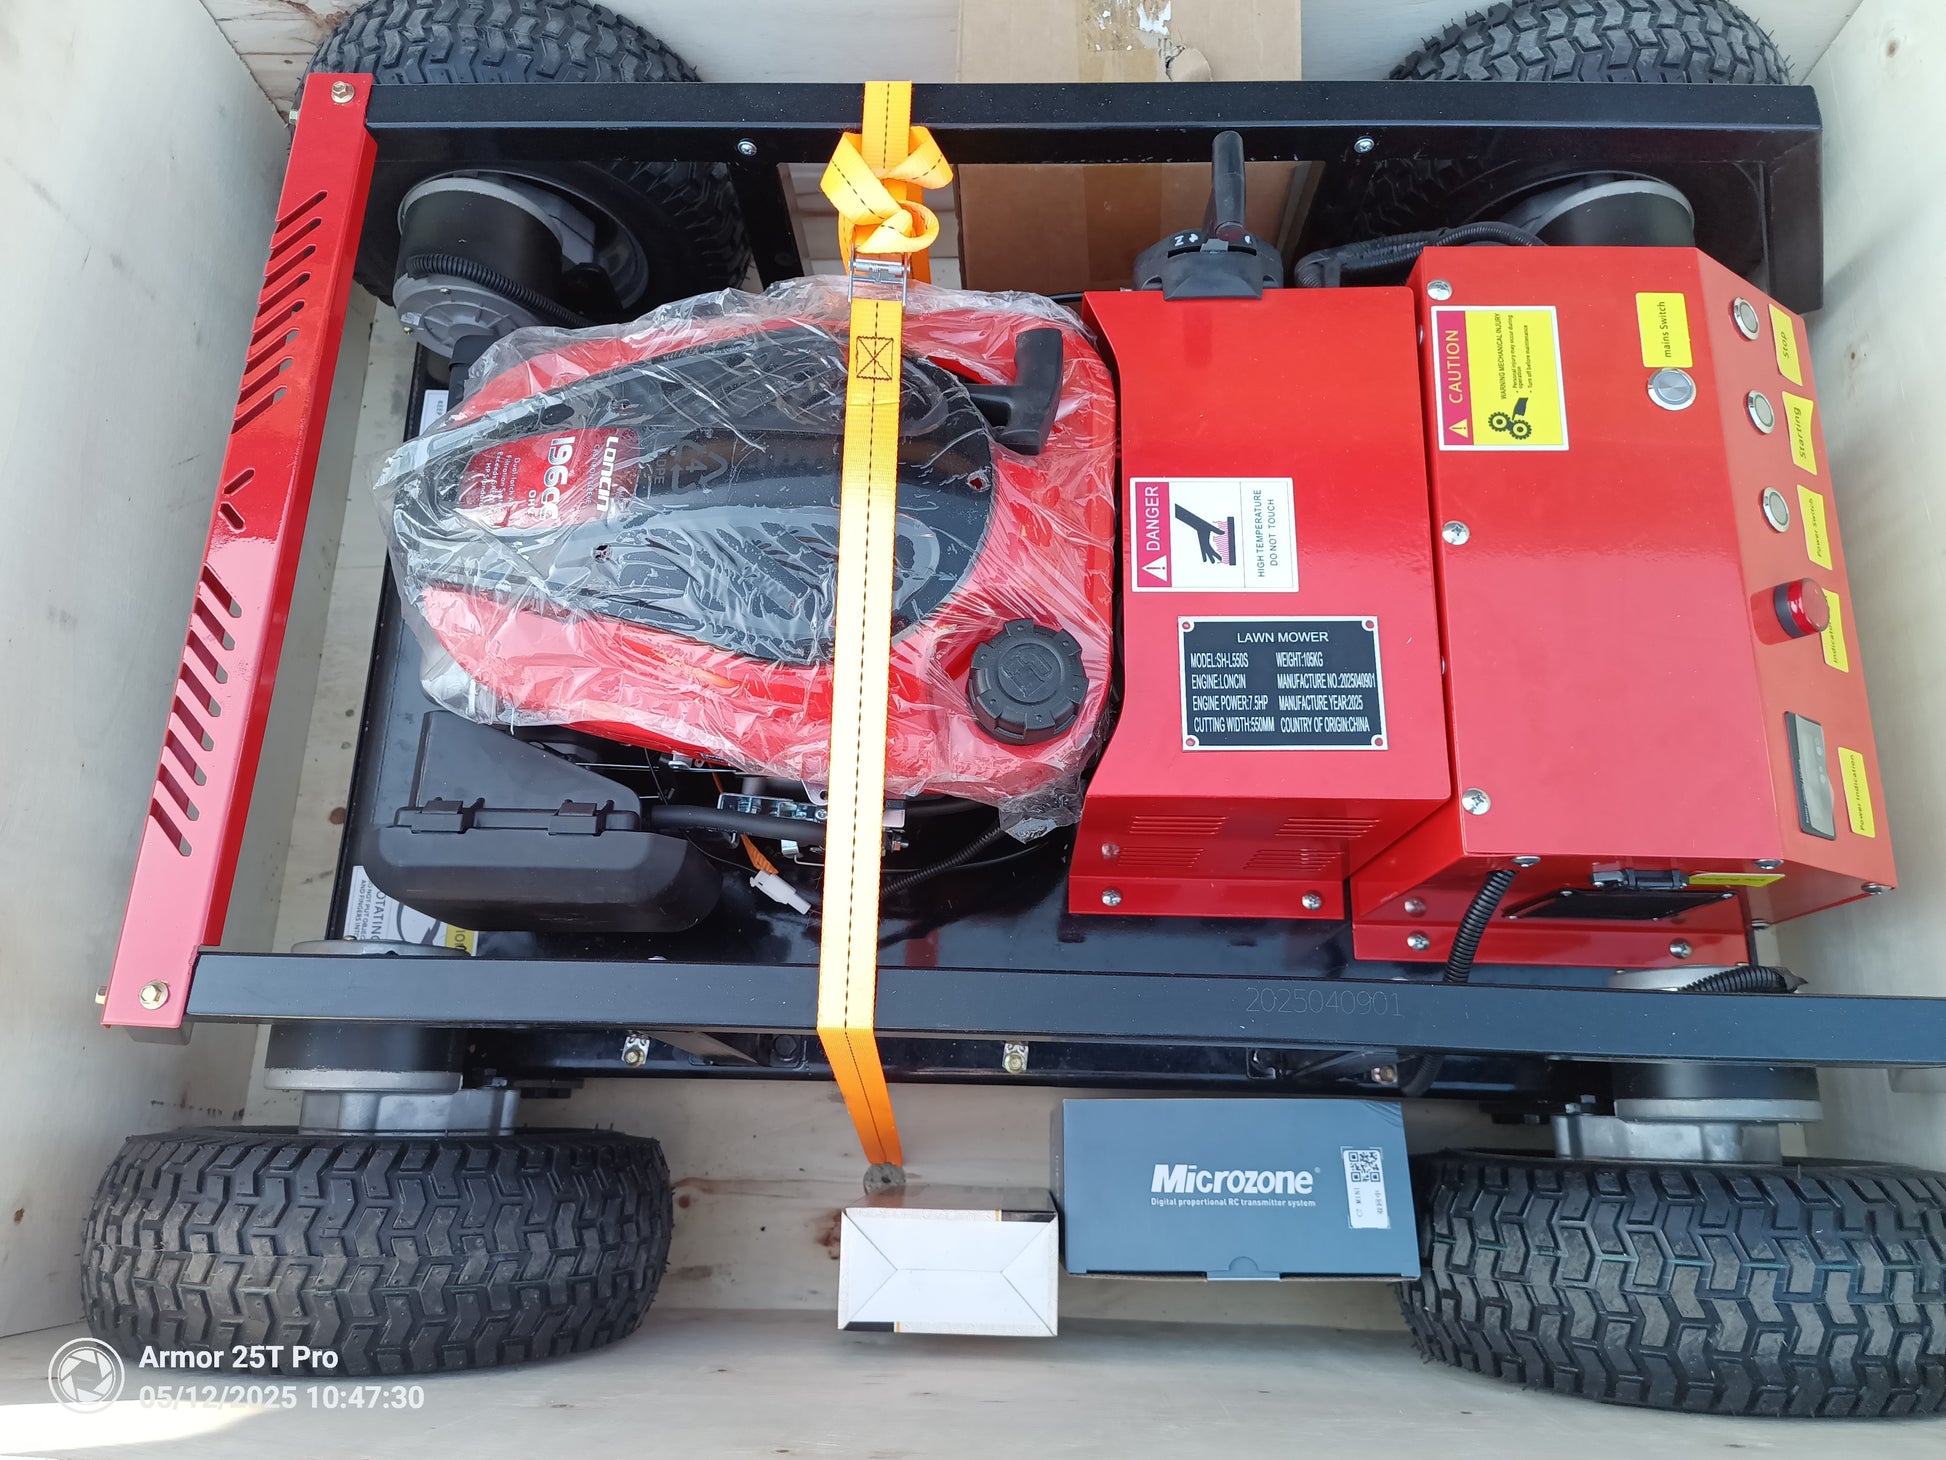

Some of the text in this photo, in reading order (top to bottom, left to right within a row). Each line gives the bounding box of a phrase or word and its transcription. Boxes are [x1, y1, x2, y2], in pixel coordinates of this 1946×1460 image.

[1656, 301, 1672, 358] mains Switch
[1494, 313, 1507, 400] WARNING MECHANICAL INJURY
[1781, 331, 1789, 359] Stop
[1445, 330, 1463, 404] CAUTION
[1794, 406, 1807, 459] Starting
[1144, 486, 1160, 551] DANGER
[1267, 499, 1278, 566] DO NOT TOUCH
[1808, 498, 1822, 558] Power Switch
[1253, 490, 1264, 578] HIGH TEMPERATURE
[1237, 632, 1329, 643] LAWN MOWER
[1190, 652, 1249, 668] MODEL:SH-L550S
[1276, 652, 1324, 668] WEIGHT:105KG
[1192, 674, 1246, 690] ENGINE:LONCIN
[1277, 674, 1326, 689] MANUFACTURE
[1192, 694, 1268, 711] ENGINE POWER:7.5HP
[1278, 694, 1364, 711] MANUFACTURE YEAR:2025
[1194, 716, 1275, 732] CUTTING WIDTH:550MM
[1280, 716, 1370, 732] COUNTRY OF ORIGIN:CHINA
[356, 894, 364, 922] FINGERS
[364, 889, 372, 904] NOT
[1246, 987, 1403, 1016] 2025040901
[1151, 1164, 1314, 1194] Microzone
[1151, 1198, 1316, 1208] Digital proportional RC transmitter system
